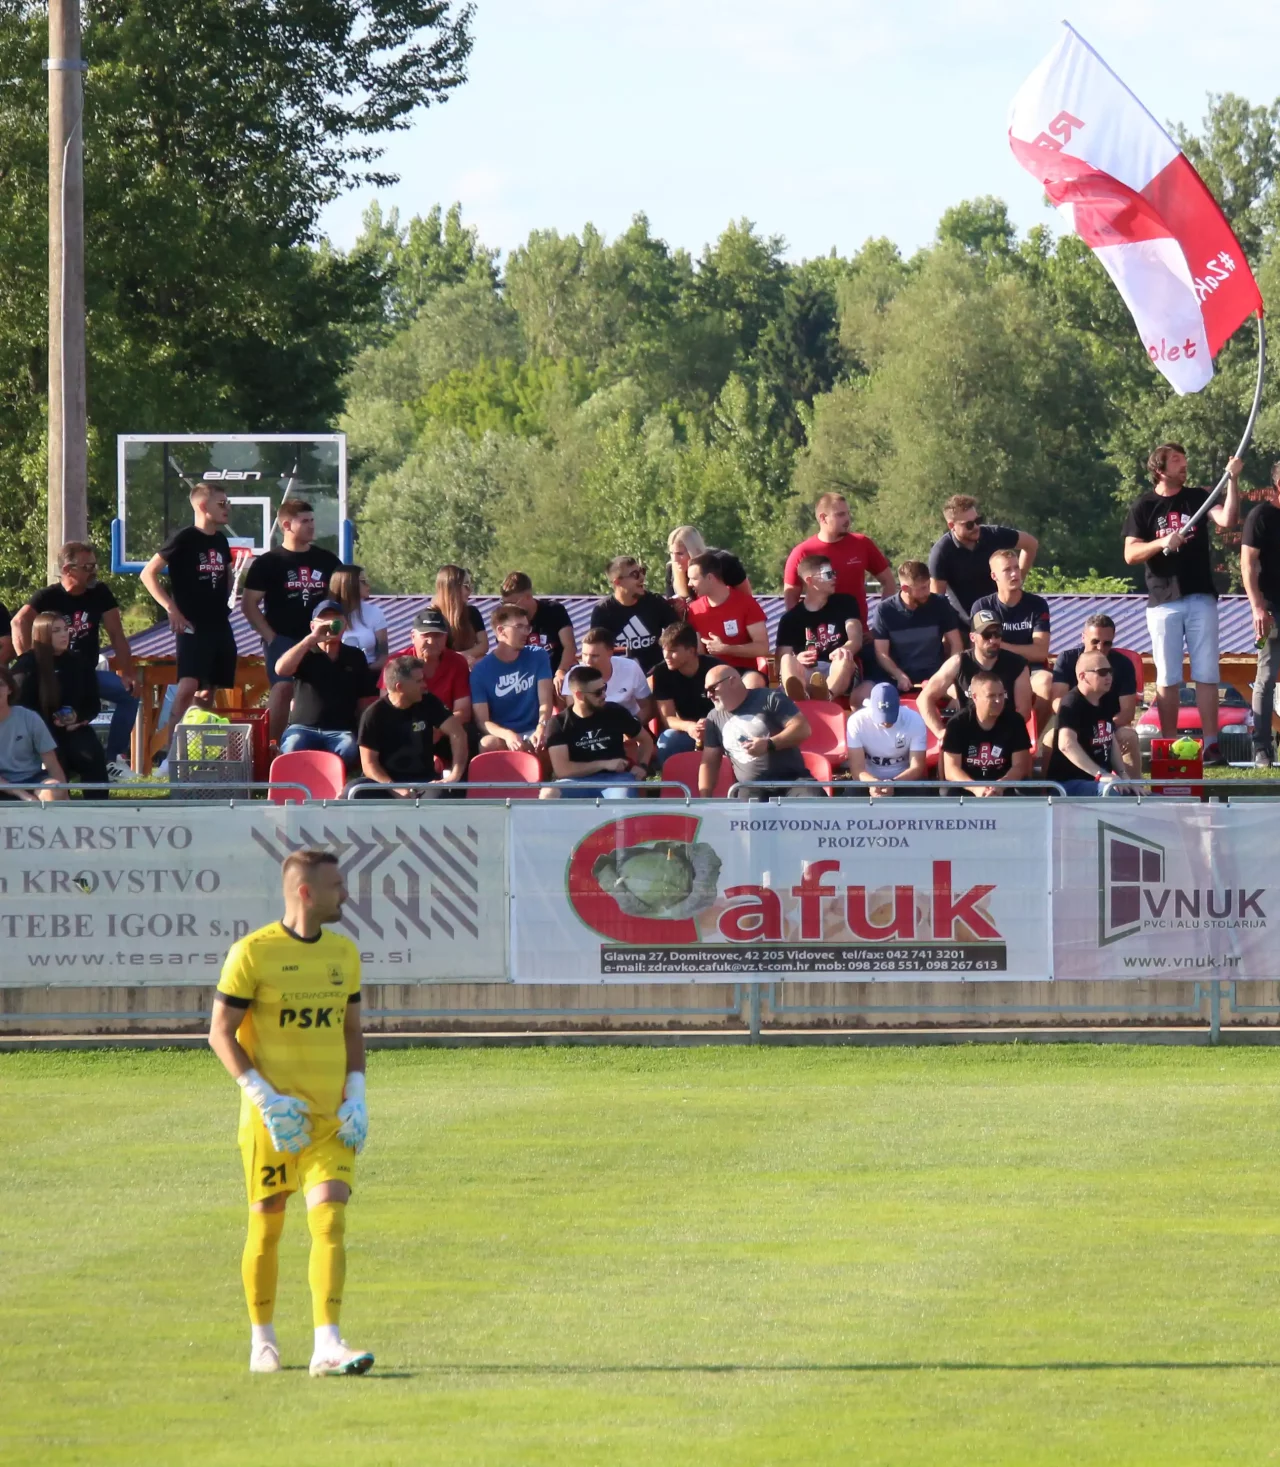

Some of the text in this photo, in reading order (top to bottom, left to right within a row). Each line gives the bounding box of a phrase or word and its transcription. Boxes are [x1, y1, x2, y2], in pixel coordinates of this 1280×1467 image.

[203, 469, 261, 480] elan
[288, 581, 324, 589] PRVACI
[498, 671, 519, 688] JUST
[729, 818, 997, 831] PROIZVODNJA POLJOPRIVREDNIH
[0, 826, 193, 849] ESARSTVO
[817, 836, 910, 848] PROIZVODA
[21, 869, 221, 894] KROVSTVO
[565, 813, 1003, 945] Cafuk
[1142, 888, 1268, 919] VNUK
[106, 912, 199, 938] IGOR
[1143, 920, 1170, 929] PVC
[1176, 920, 1200, 929] ALU
[1203, 919, 1267, 929] STOLARIJA
[603, 949, 965, 963] Glavna 27, Domitrovec, 42 205 Vidovec tel/fax: 042 741 3201
[1123, 954, 1242, 968] www.vnuk.hr
[603, 960, 999, 973] e-mail: zdravko.cafuk@vz.t-com.hr mob: 098 268 551, 098 267 613
[279, 1006, 333, 1030] PSK
[261, 1162, 287, 1188] 21
